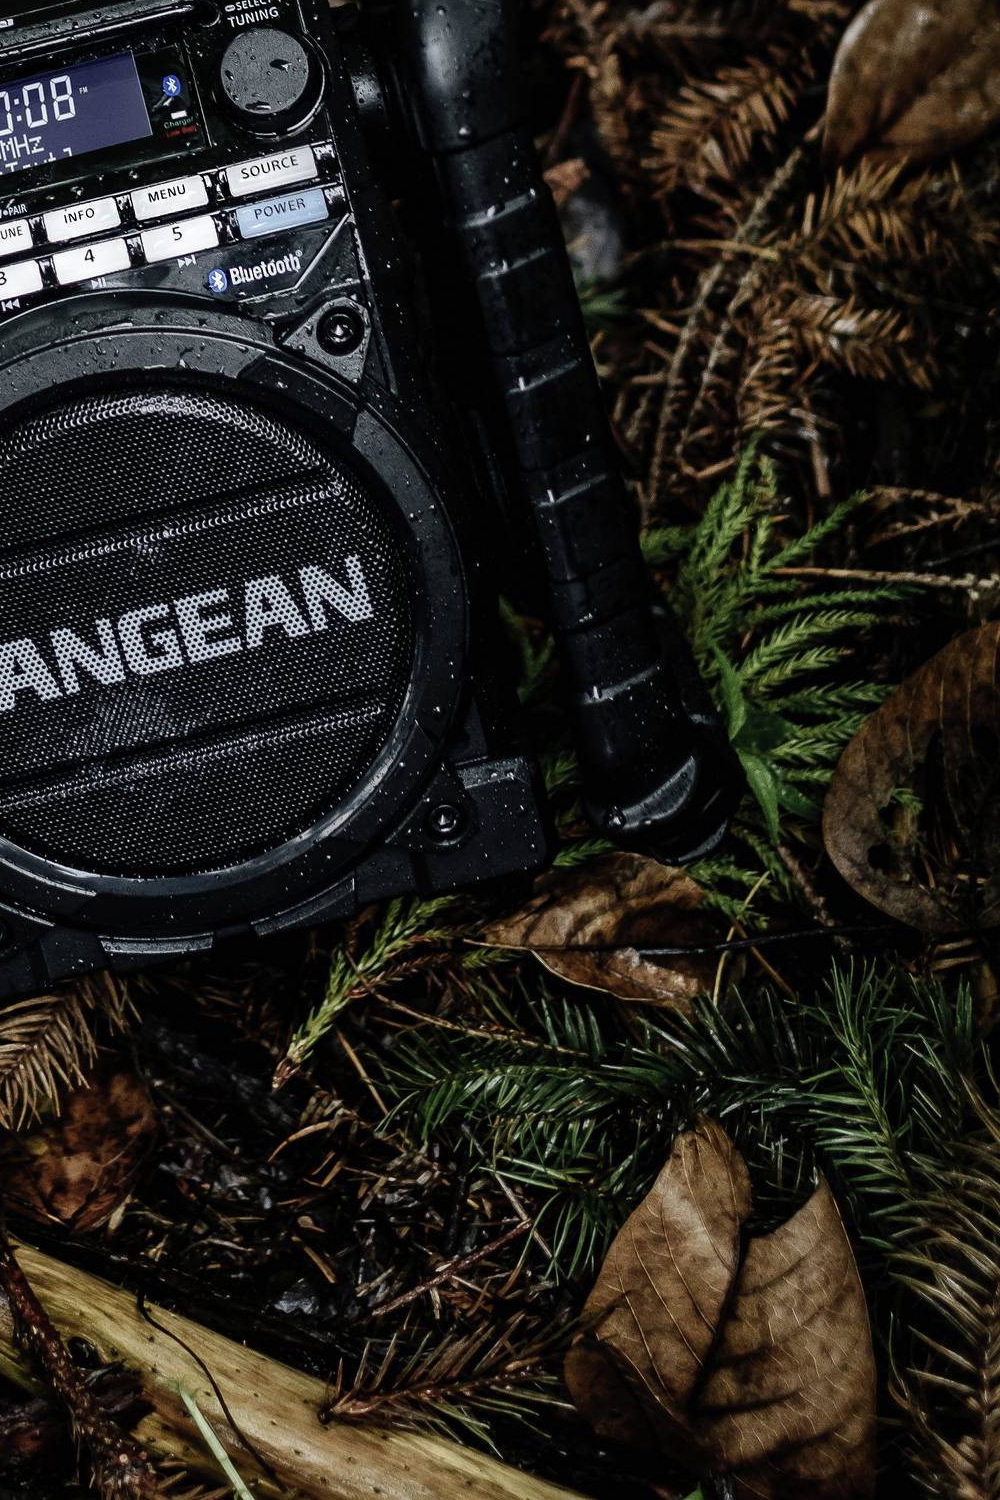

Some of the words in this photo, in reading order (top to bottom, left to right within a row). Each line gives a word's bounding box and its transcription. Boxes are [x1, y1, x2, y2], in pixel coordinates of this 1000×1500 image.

[227, 6, 279, 27] TUNING
[79, 86, 88, 94] FM
[241, 155, 298, 179] SOURCE
[148, 184, 186, 203] MENU
[63, 207, 95, 224] INFO
[254, 198, 306, 220] POWER
[172, 226, 182, 241] 5
[84, 249, 95, 263] 4
